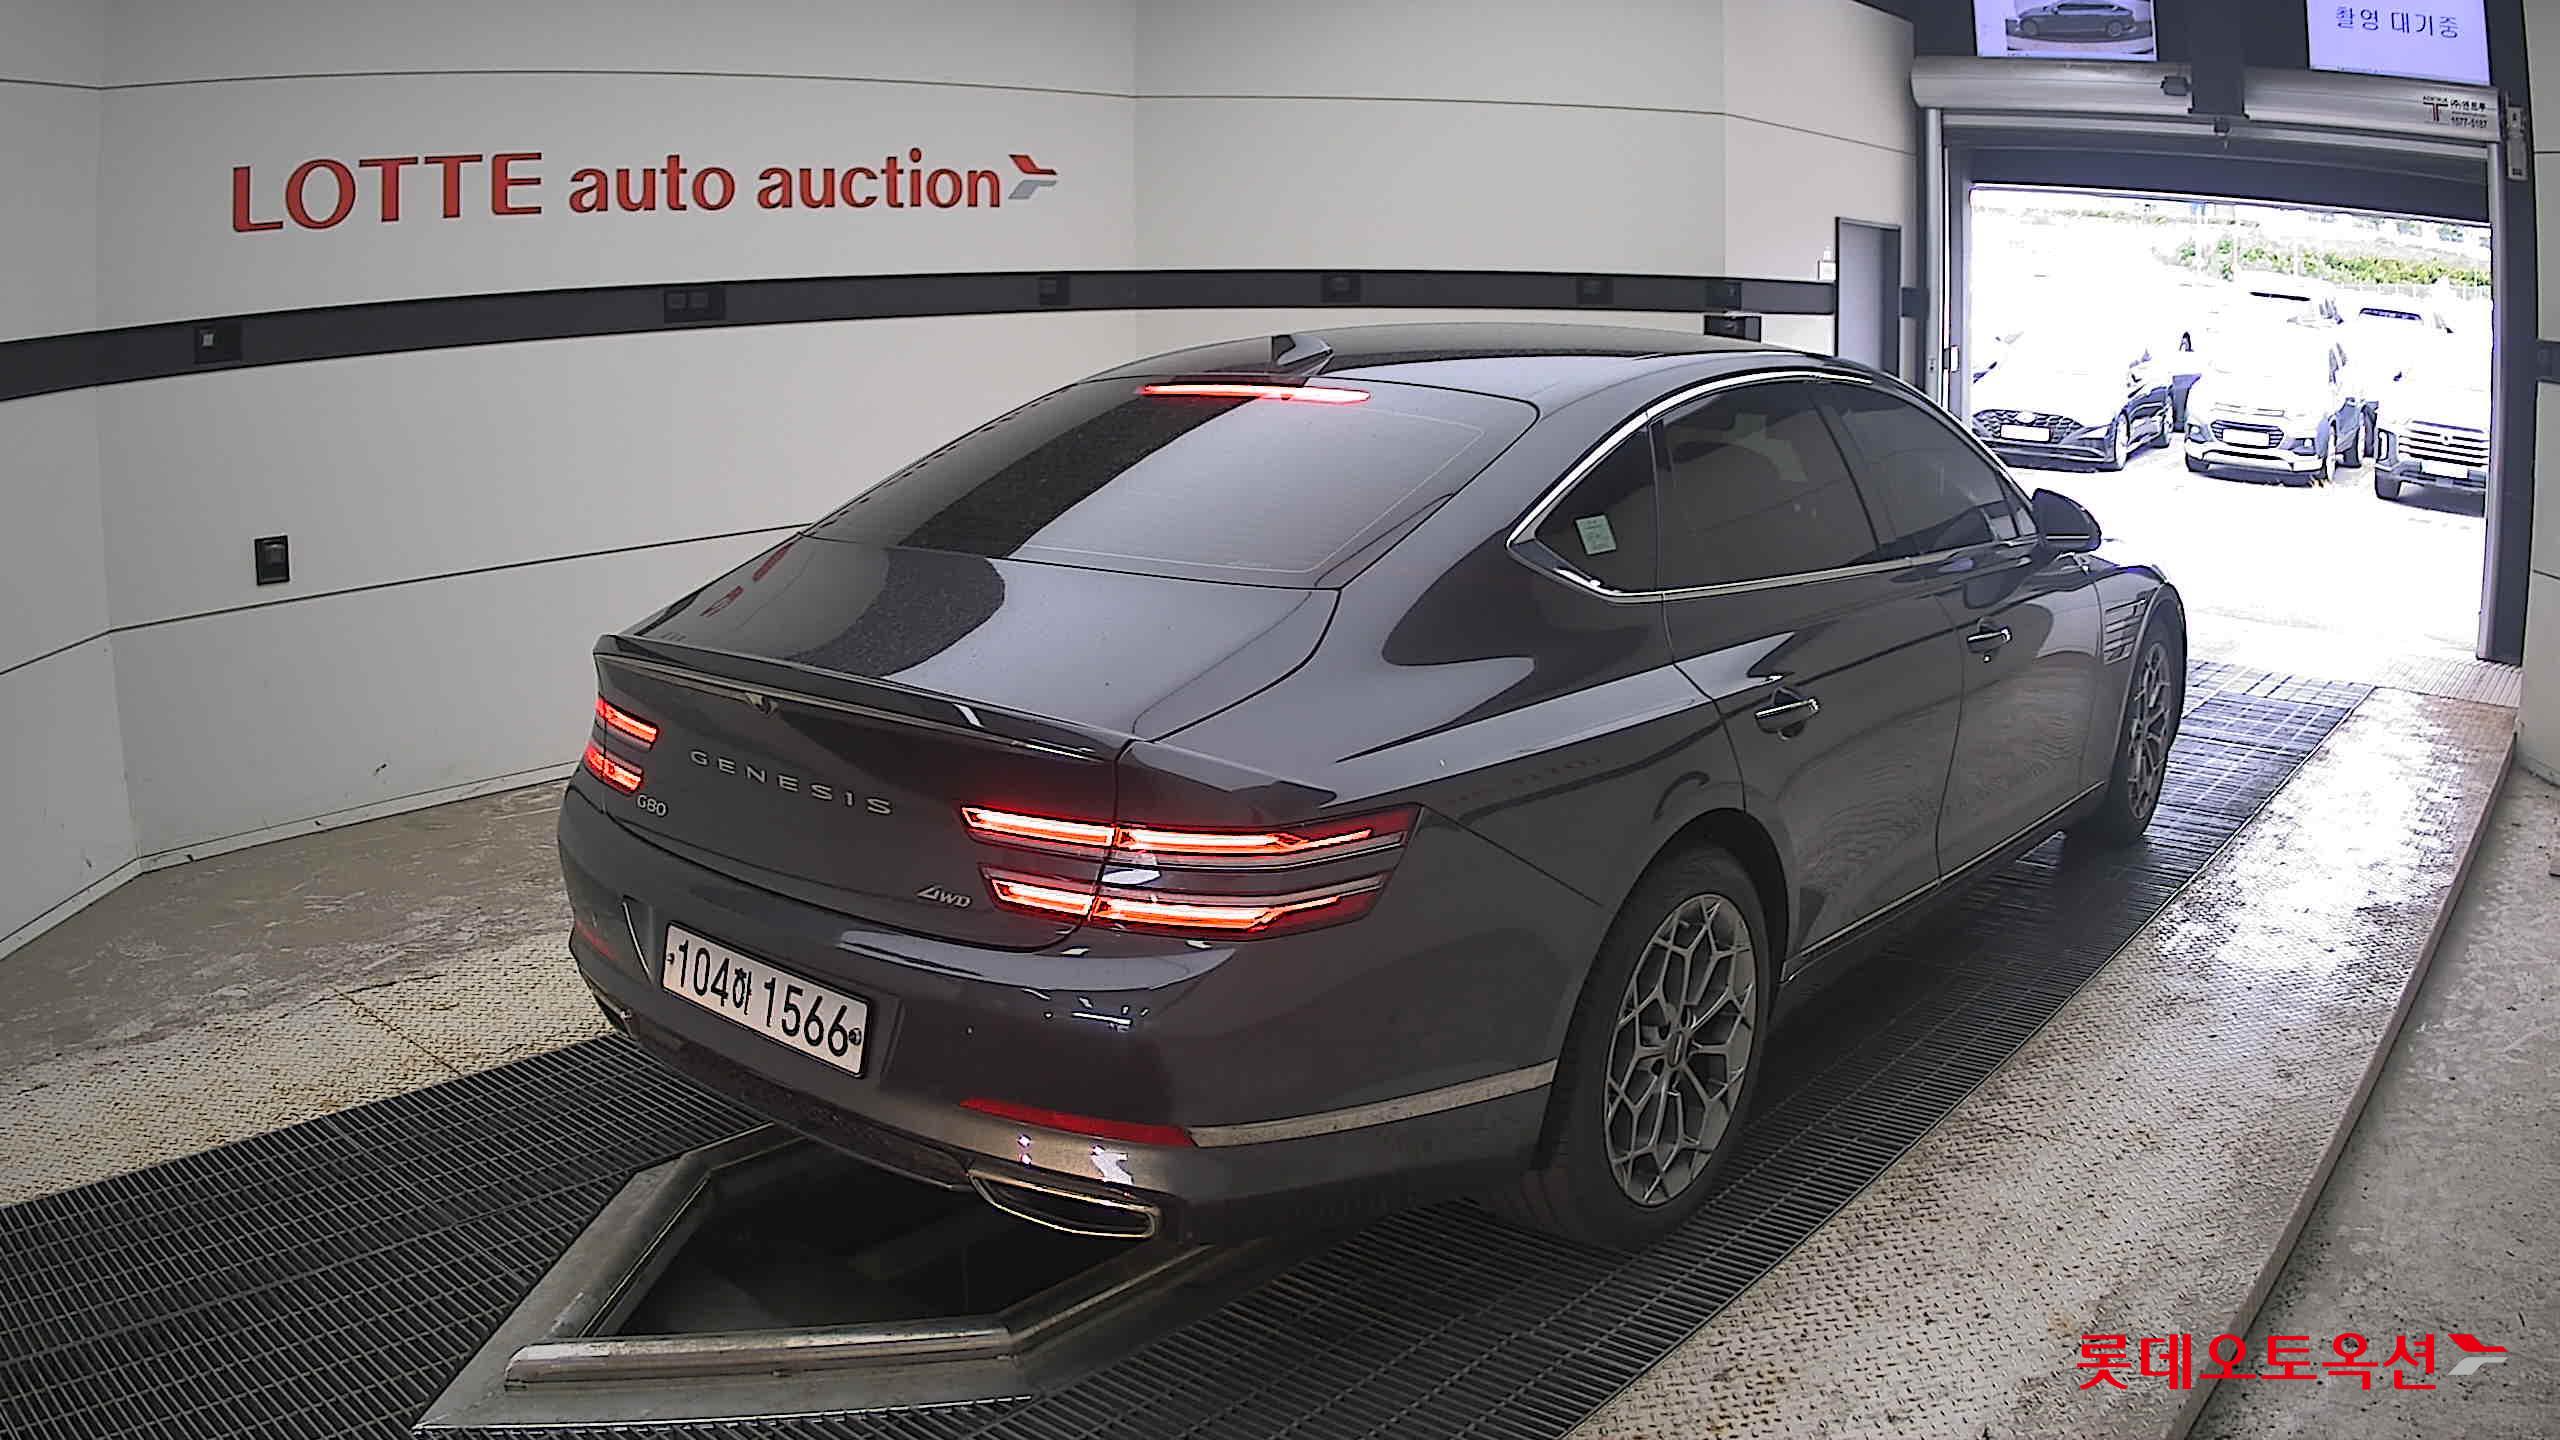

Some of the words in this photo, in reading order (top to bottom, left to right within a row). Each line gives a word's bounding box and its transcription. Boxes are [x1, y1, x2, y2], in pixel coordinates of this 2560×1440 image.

[2391, 12, 2459, 39] 대기중
[233, 152, 542, 233] LOTTE
[568, 154, 736, 214] auto
[757, 147, 1002, 210] auction
[636, 794, 667, 817] G80
[690, 750, 893, 815] GENESIS
[679, 940, 752, 1015] 104하
[764, 977, 848, 1057] 1566
